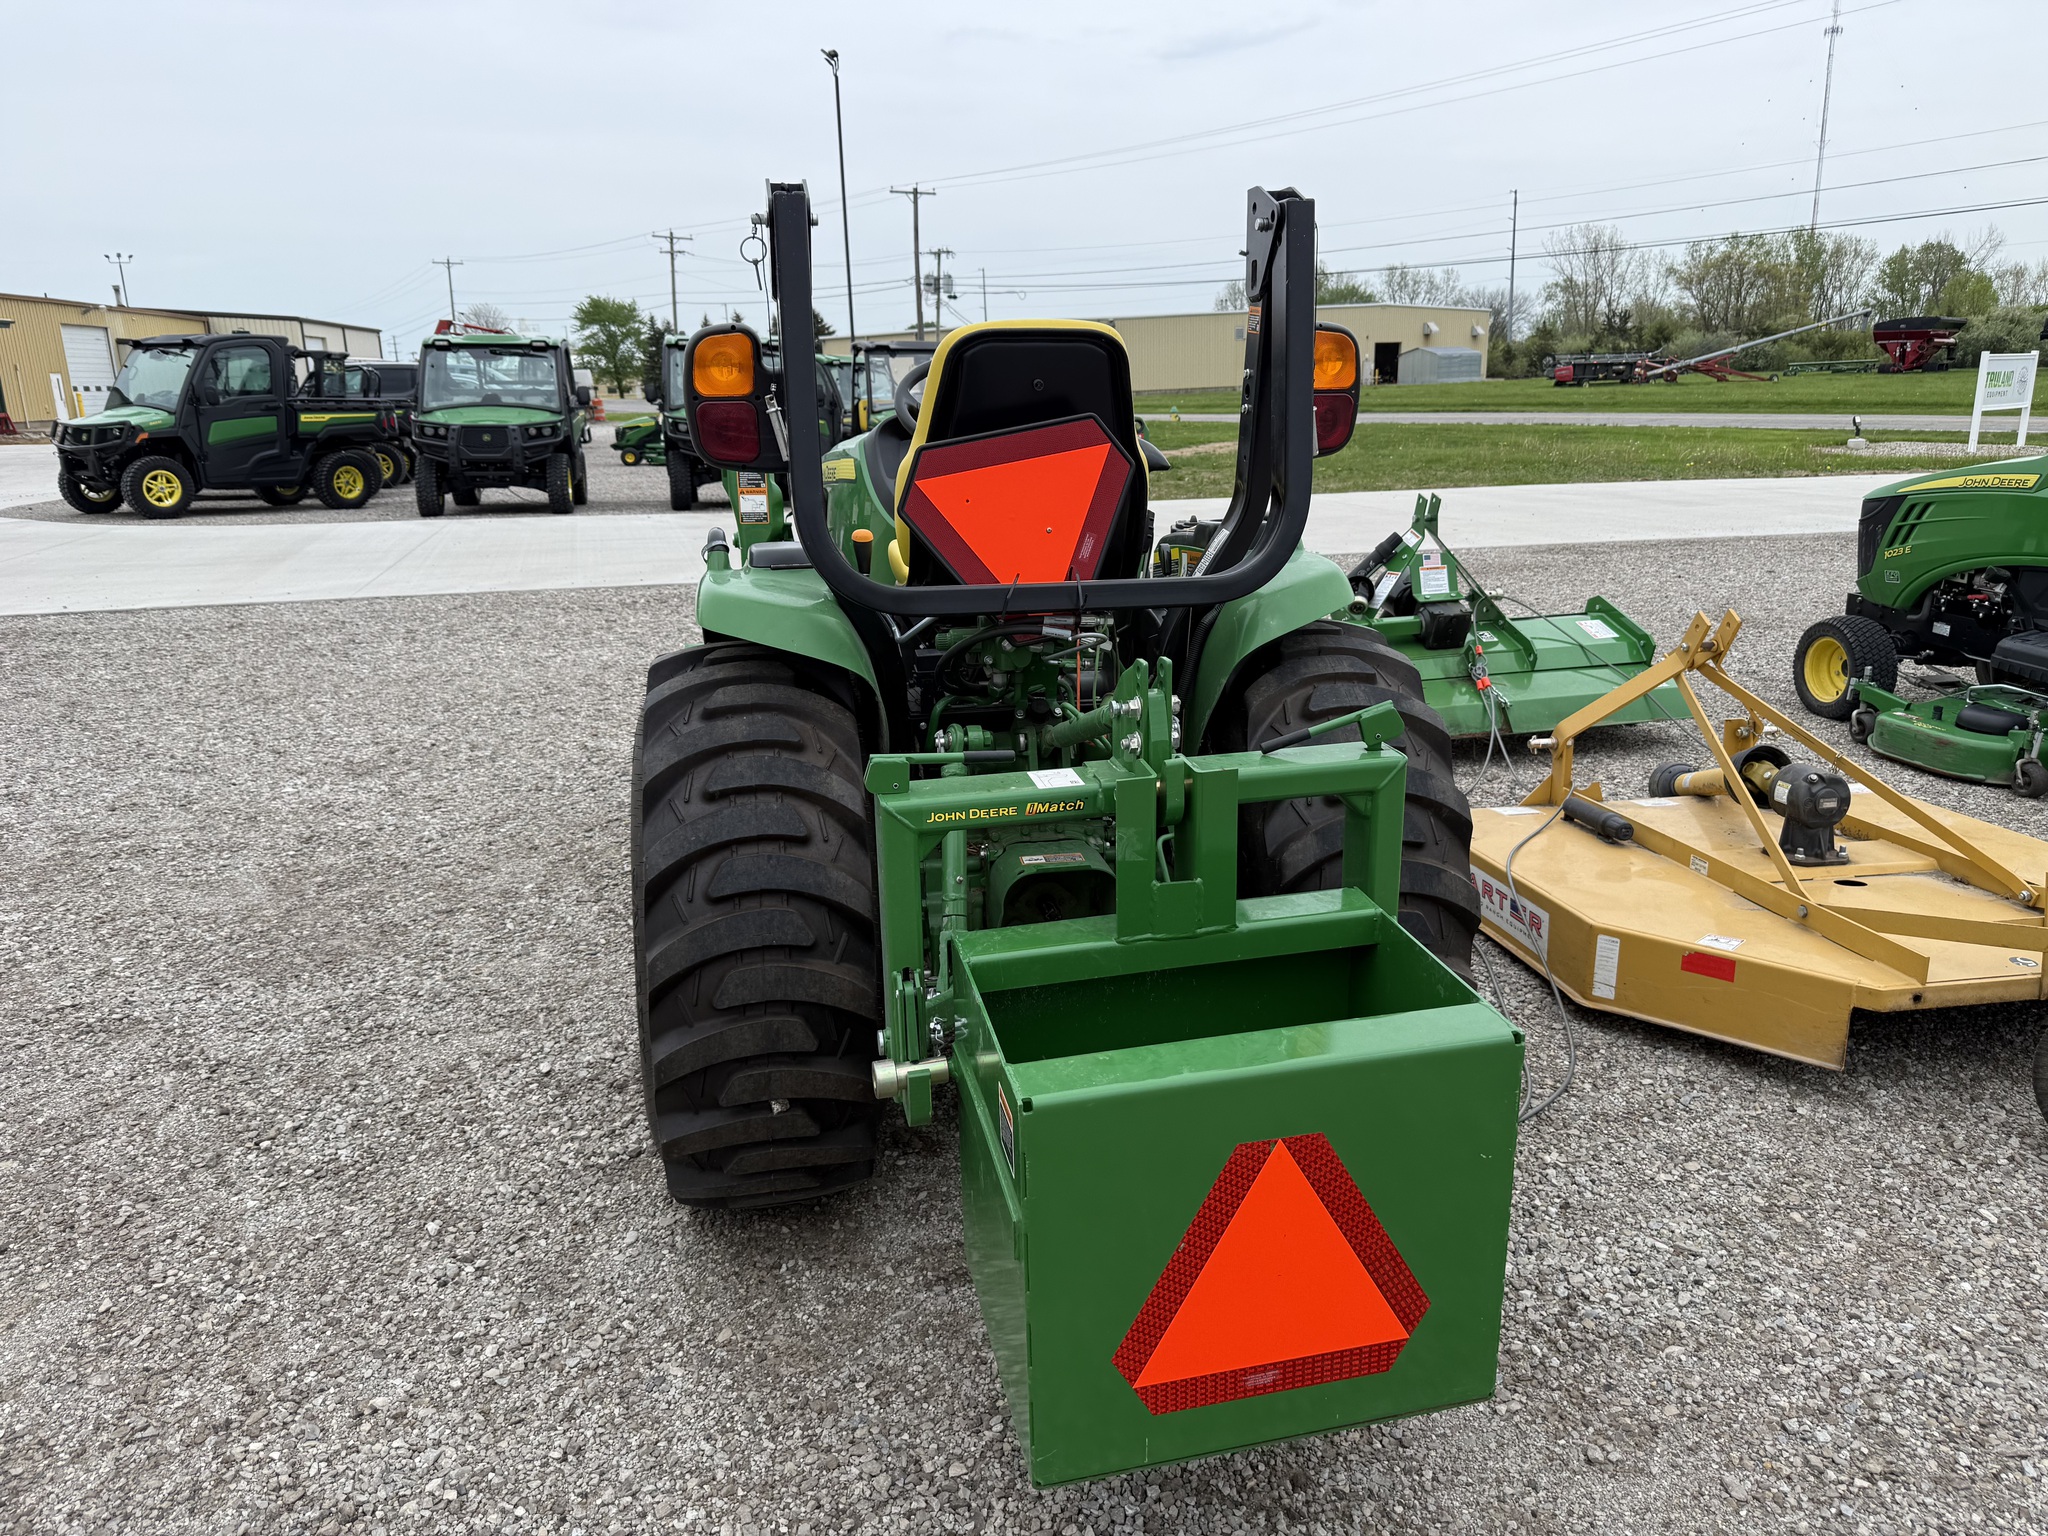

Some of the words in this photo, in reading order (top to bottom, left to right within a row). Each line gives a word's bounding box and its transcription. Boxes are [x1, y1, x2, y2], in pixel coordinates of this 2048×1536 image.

[1985, 370, 2014, 388] TRULAND
[1959, 477, 1990, 487] JOHN
[1991, 476, 2031, 487] DEERE
[1884, 547, 1904, 559] 1023
[1905, 546, 1912, 554] E
[926, 811, 966, 823] JOHN
[969, 806, 1018, 819] DEERE
[1025, 799, 1085, 816] iMatch
